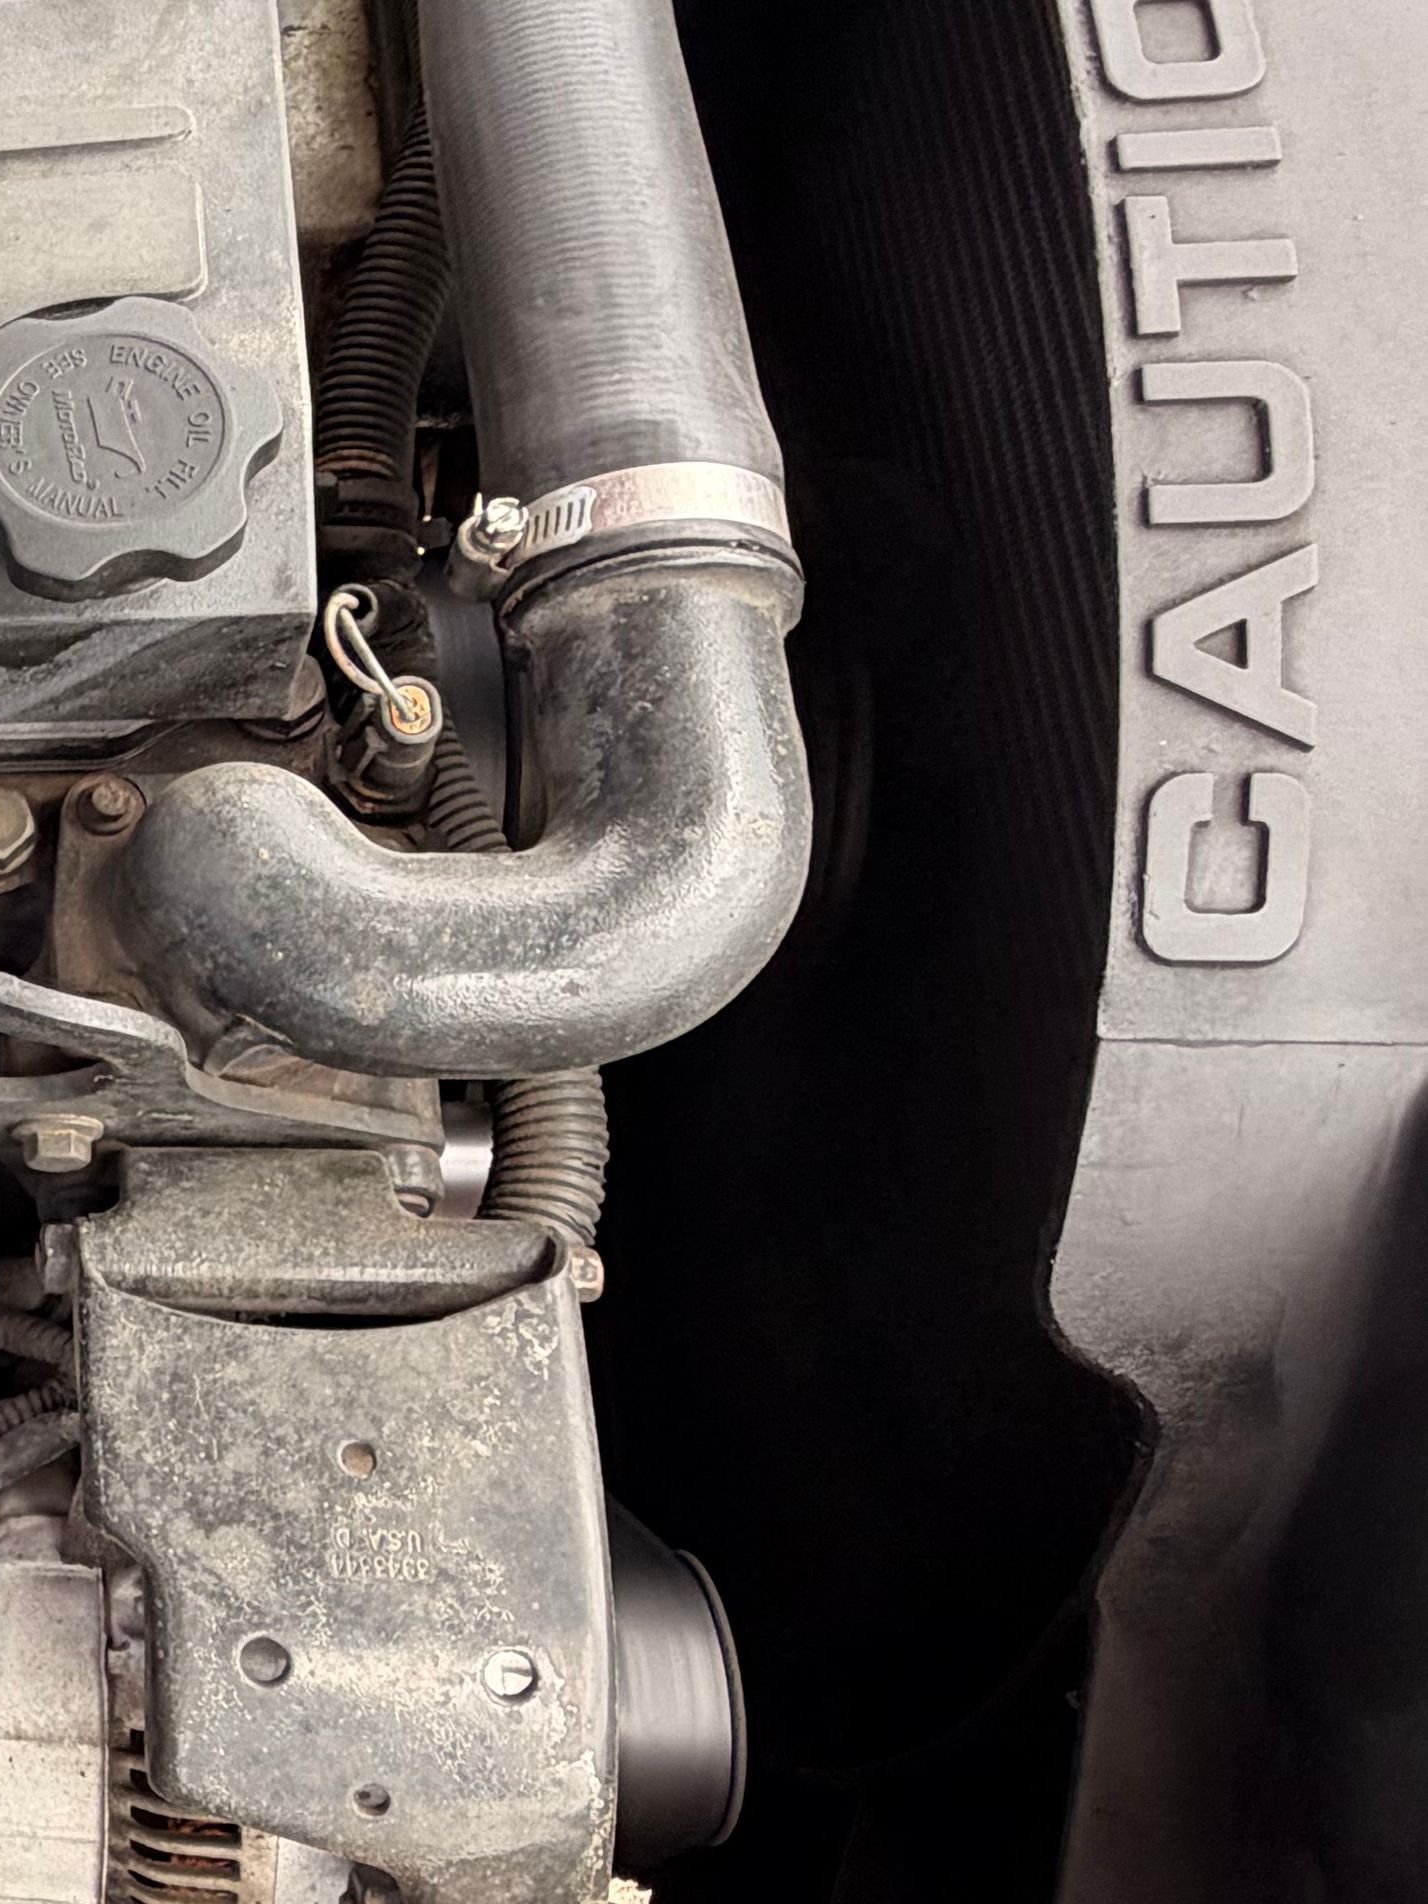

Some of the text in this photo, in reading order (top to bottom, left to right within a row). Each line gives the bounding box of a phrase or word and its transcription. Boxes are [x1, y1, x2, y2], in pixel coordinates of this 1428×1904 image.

[43, 346, 88, 380] SEE
[109, 343, 212, 501] ENGINE OIL FILL
[26, 477, 125, 518] MANUAL
